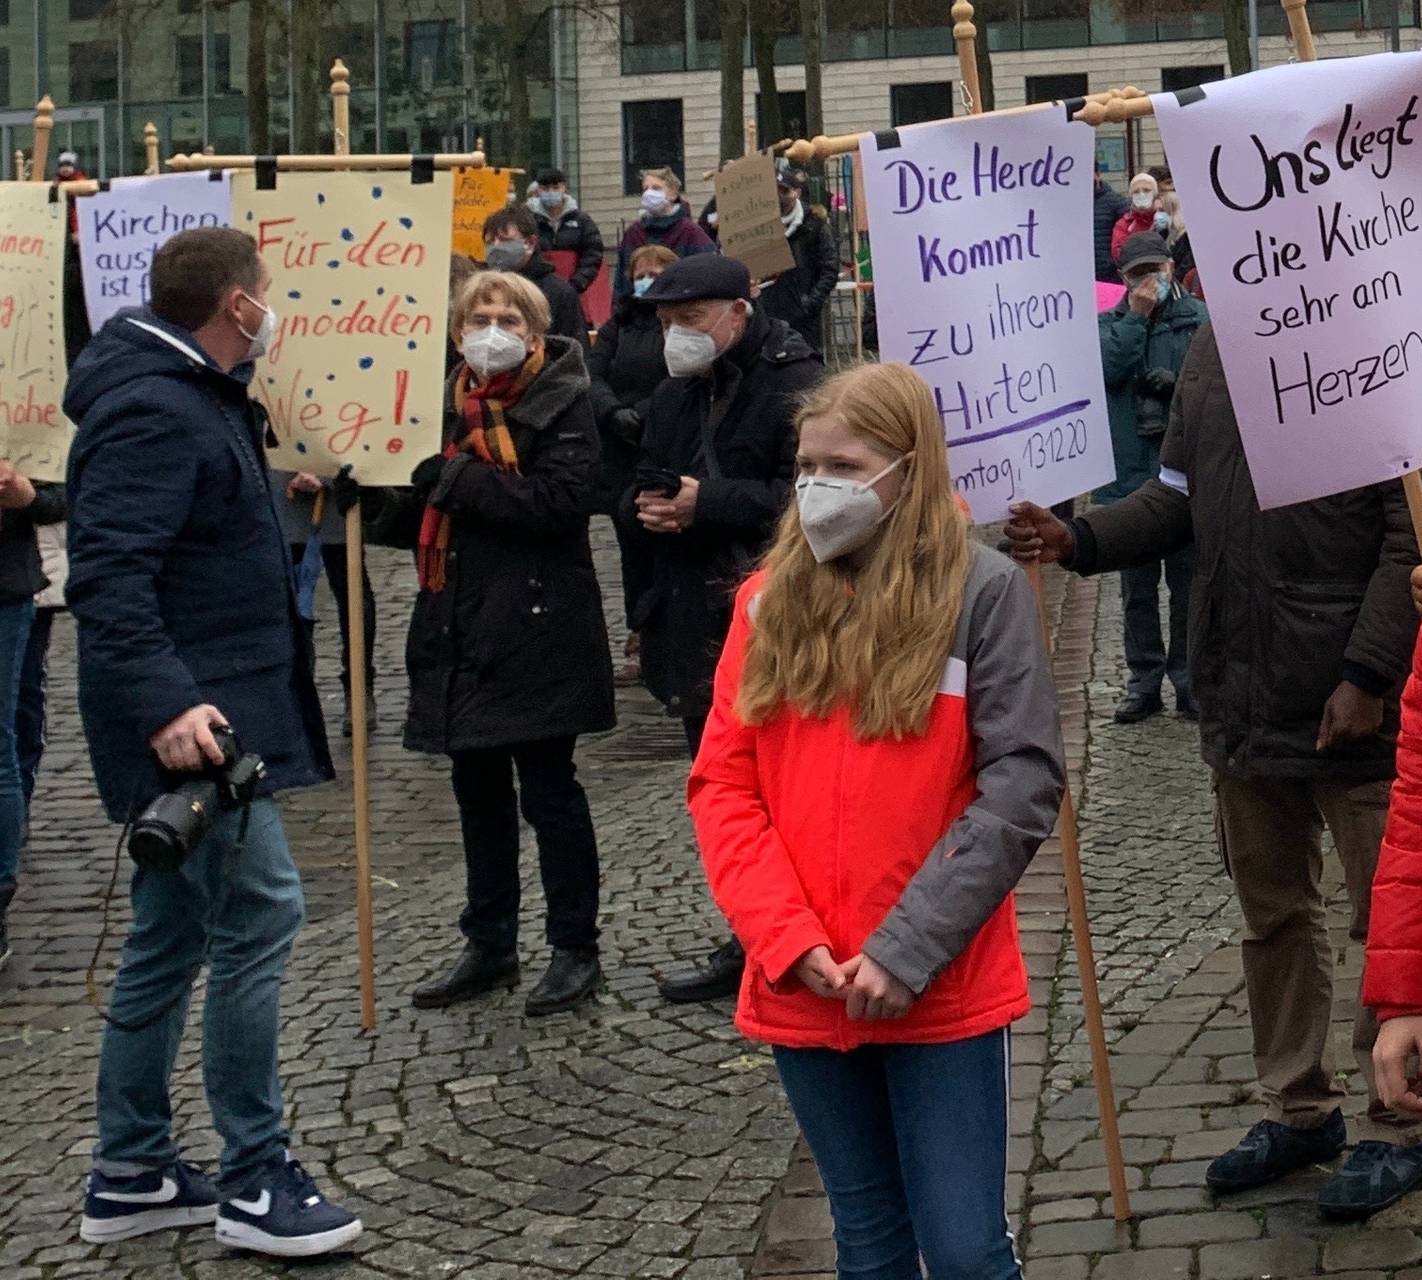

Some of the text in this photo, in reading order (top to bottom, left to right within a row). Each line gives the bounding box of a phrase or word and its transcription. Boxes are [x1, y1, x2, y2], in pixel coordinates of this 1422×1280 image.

[884, 142, 1074, 214] Die Herde
[1210, 95, 1418, 211] Uns liegt
[258, 217, 426, 268] Für den
[1232, 192, 1419, 285] die Kirche
[102, 276, 130, 297] ist
[988, 283, 1073, 341] ihrem
[1255, 270, 1402, 337] sehr am
[268, 295, 432, 364] ynodalen
[934, 363, 1057, 433] Hirten
